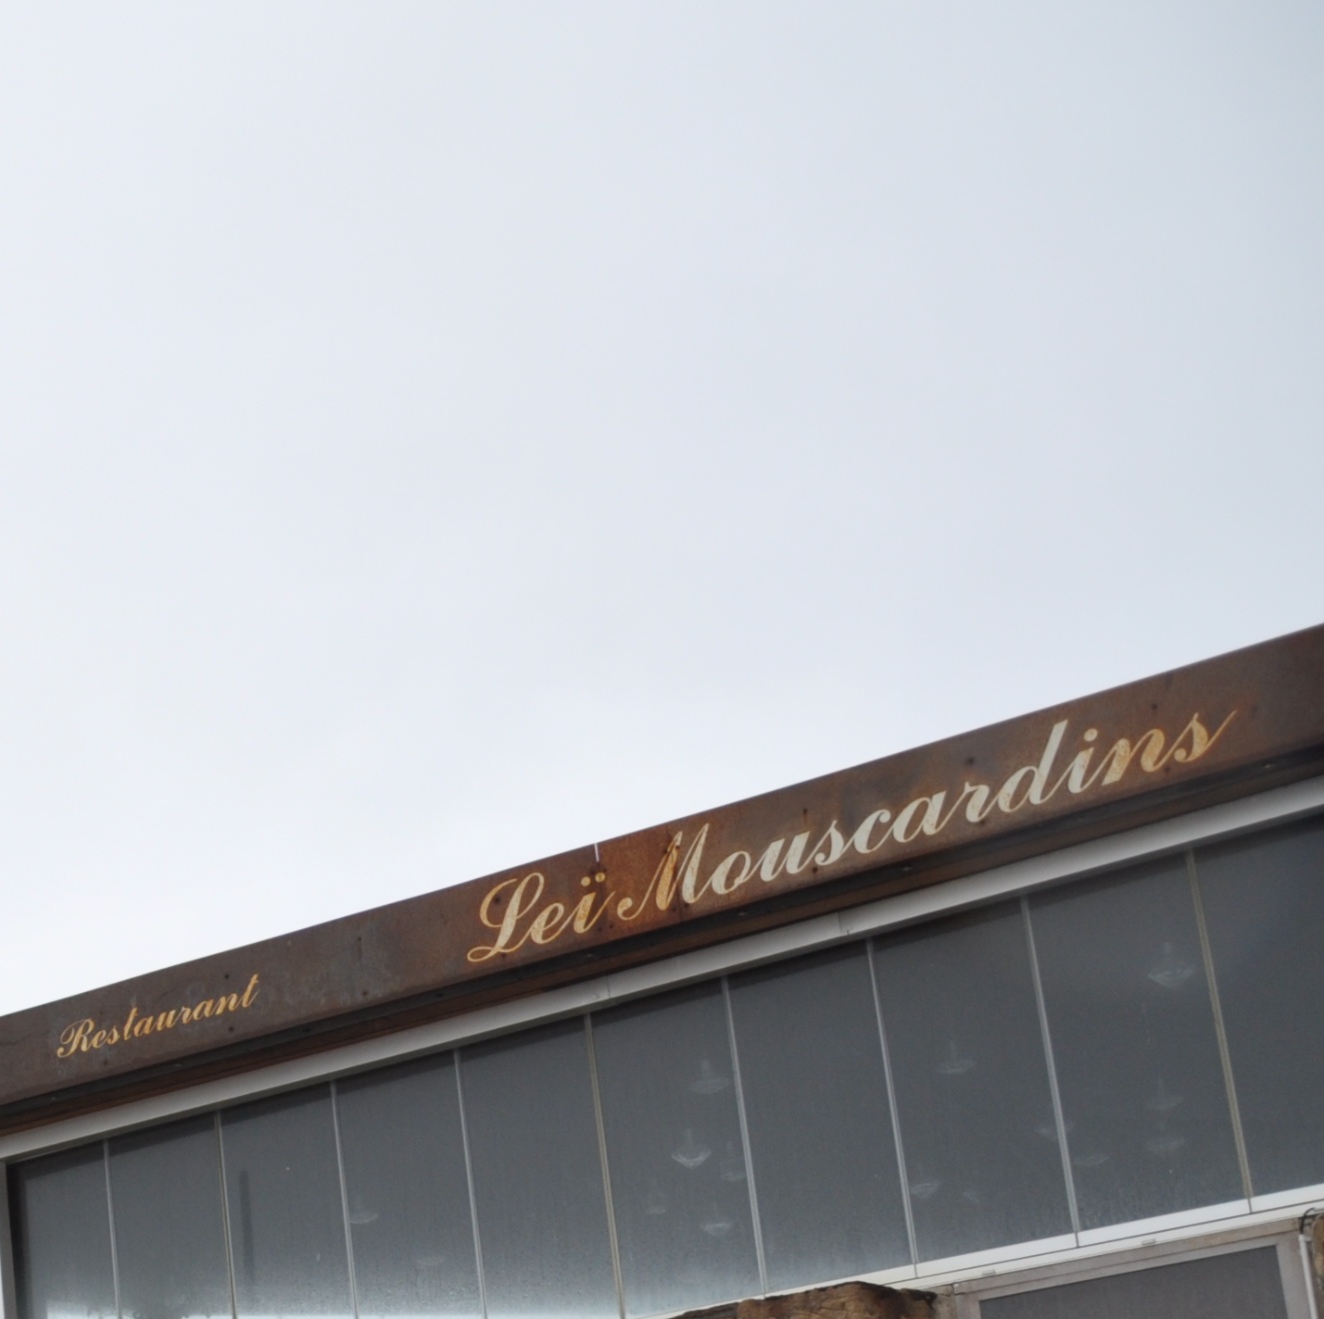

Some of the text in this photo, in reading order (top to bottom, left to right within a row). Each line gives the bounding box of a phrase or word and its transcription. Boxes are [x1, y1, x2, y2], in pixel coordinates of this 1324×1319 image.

[466, 709, 1237, 964] Leï Mouscardins
[57, 973, 261, 1058] Restaurant
